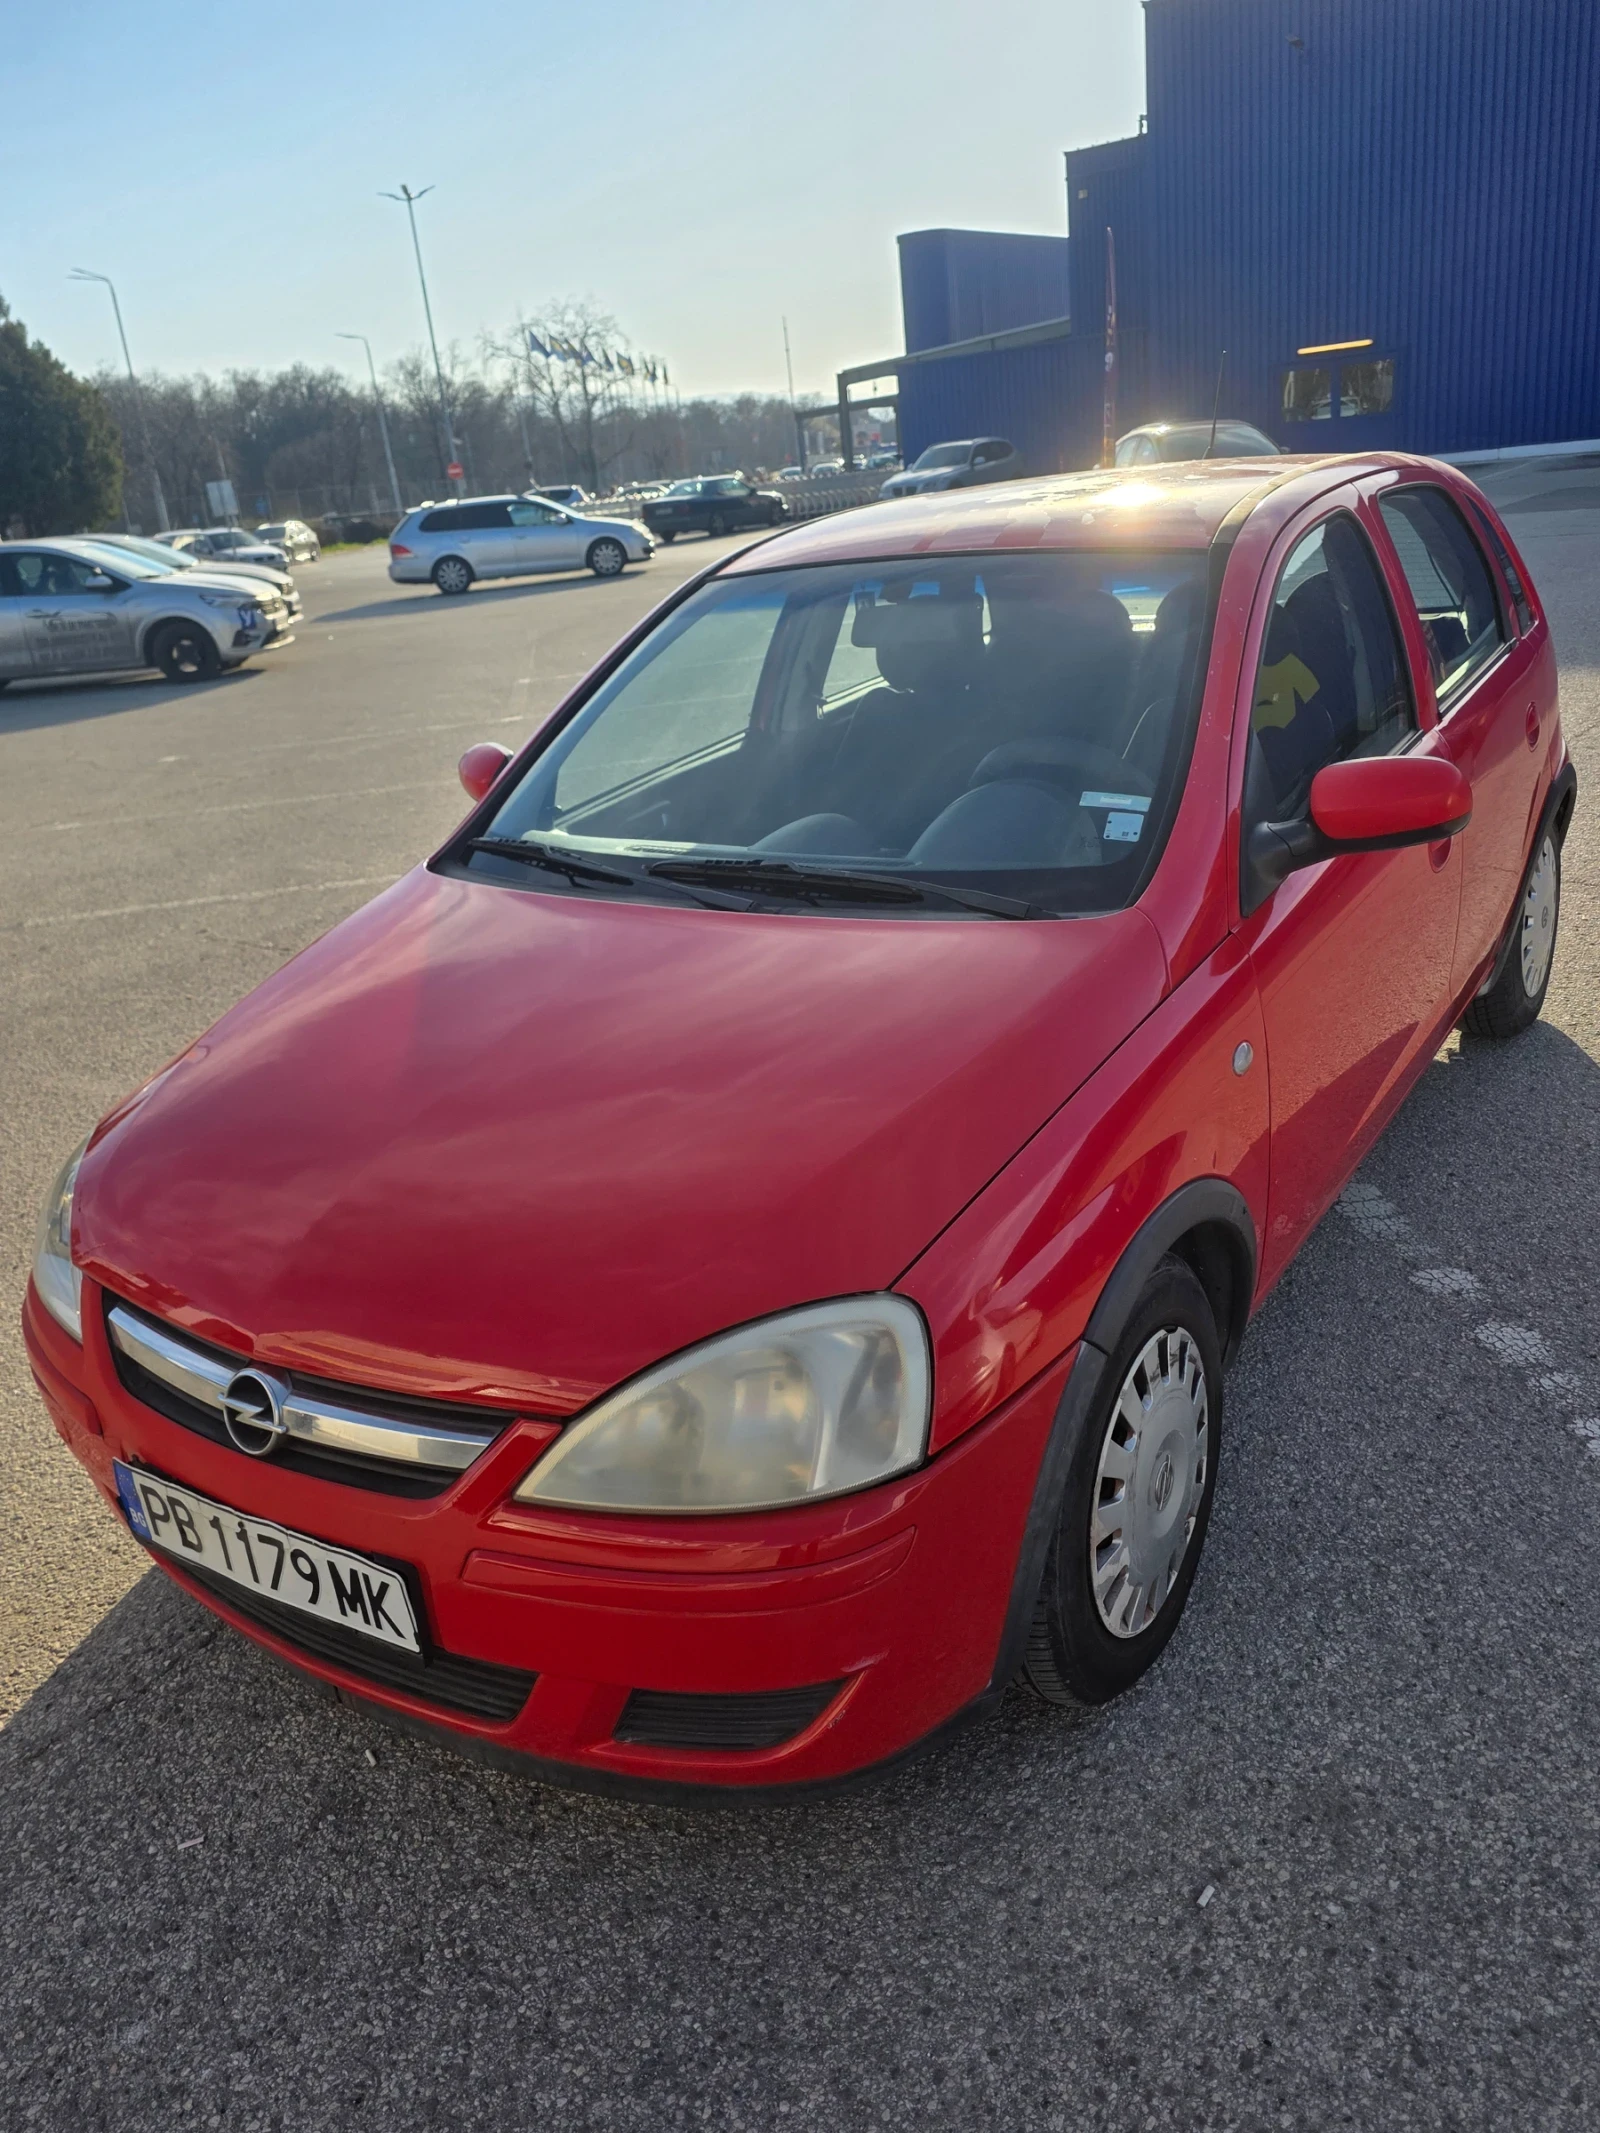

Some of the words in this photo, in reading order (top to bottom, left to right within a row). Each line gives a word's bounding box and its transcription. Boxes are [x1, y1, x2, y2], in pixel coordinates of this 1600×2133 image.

[129, 1507, 147, 1528] BG
[140, 1483, 203, 1553] PB
[208, 1515, 320, 1605] 1179
[326, 1559, 407, 1640] MK
